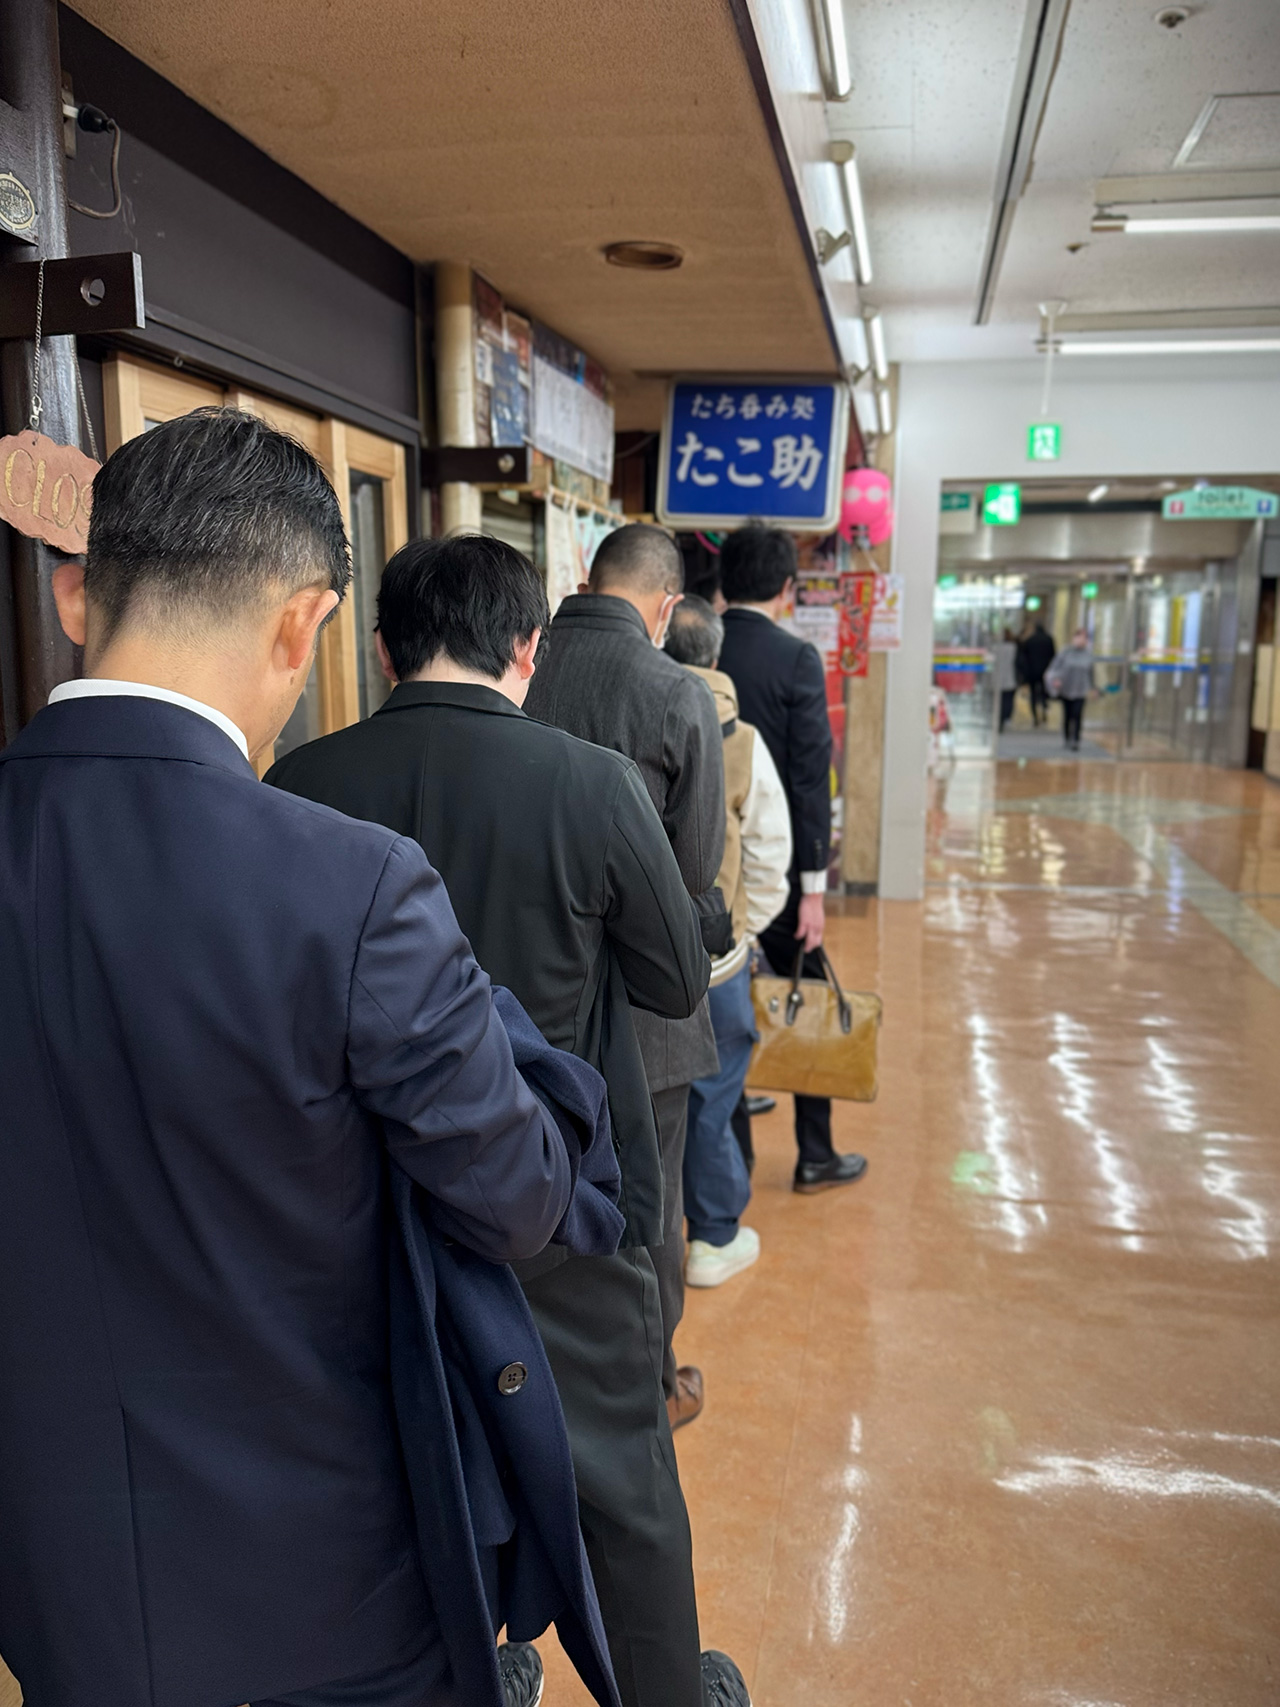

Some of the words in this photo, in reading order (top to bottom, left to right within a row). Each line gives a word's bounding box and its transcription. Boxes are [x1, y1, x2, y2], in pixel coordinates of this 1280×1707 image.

[691, 393, 815, 420] たち呑み処
[676, 432, 823, 491] たこ助
